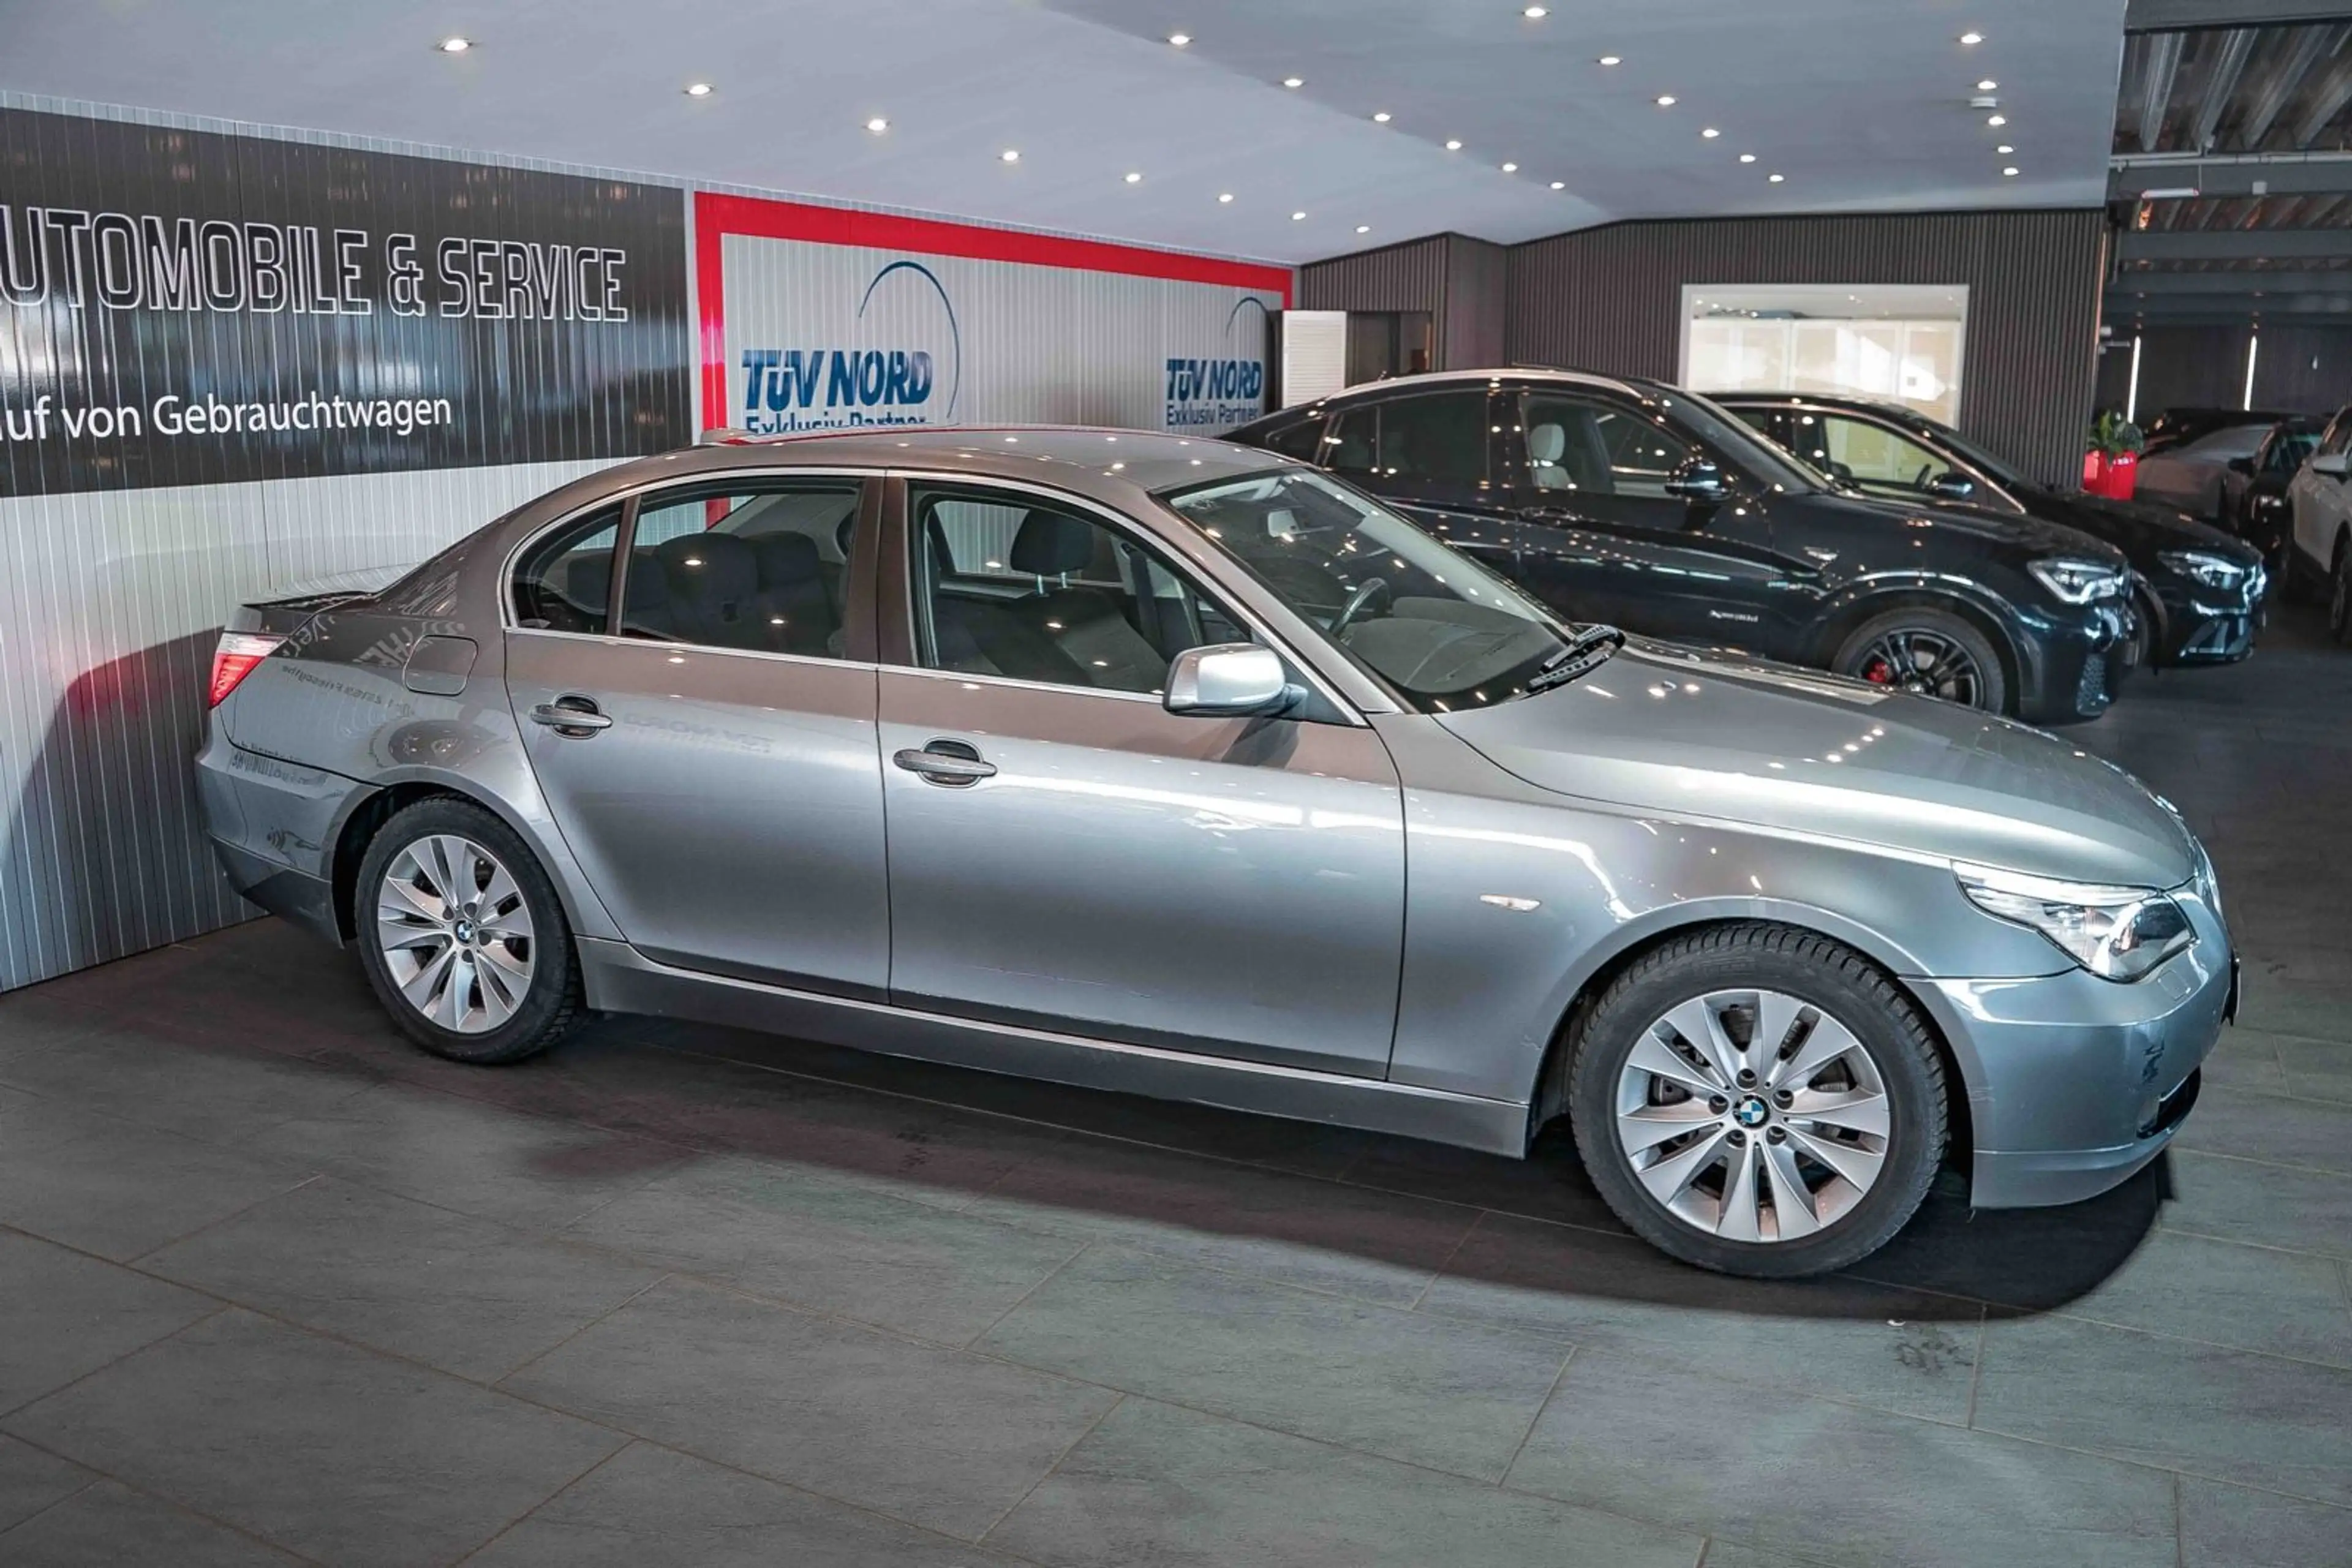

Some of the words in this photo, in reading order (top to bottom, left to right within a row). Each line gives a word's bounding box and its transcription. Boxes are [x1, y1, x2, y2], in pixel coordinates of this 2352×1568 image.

[386, 233, 426, 316] &
[438, 238, 628, 322] SERVICE
[827, 350, 932, 407] NORD
[1207, 360, 1262, 400] NORD
[0, 394, 51, 441] uf
[61, 405, 141, 439] von
[153, 391, 451, 435] Gebrauchtwagen
[1167, 402, 1215, 425] Exklusiv
